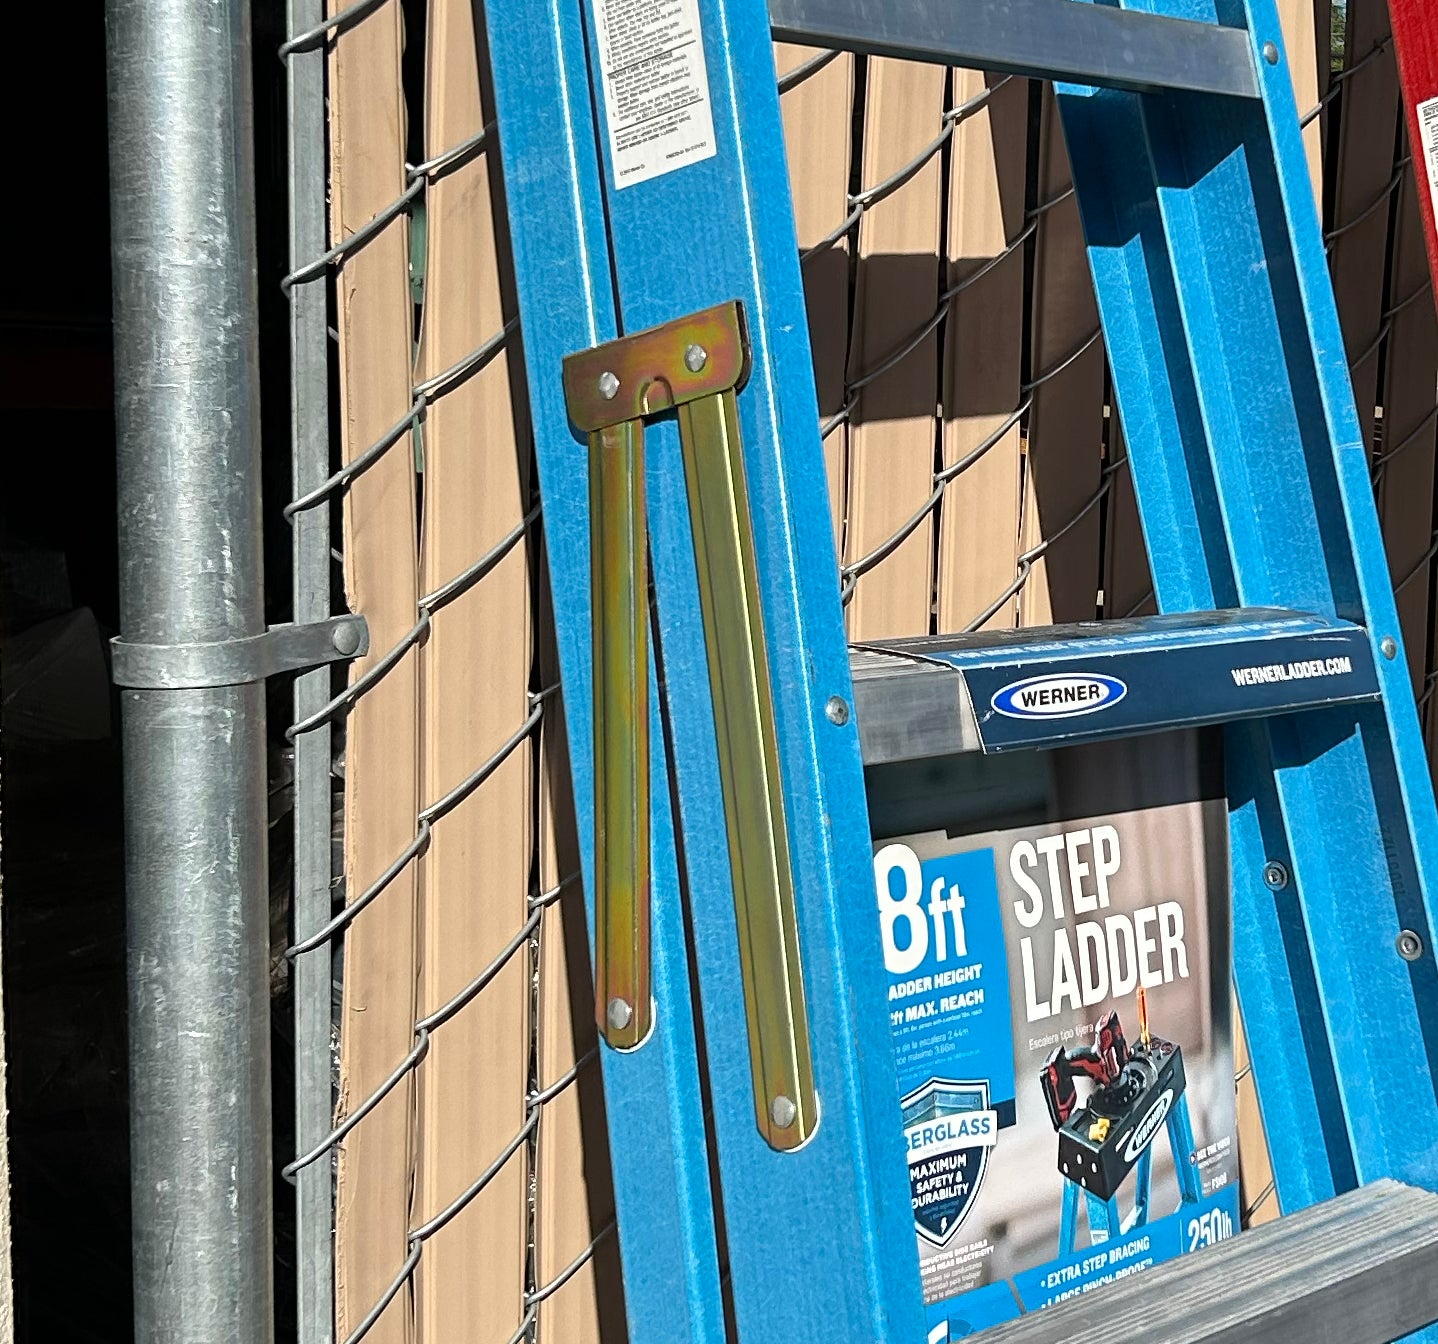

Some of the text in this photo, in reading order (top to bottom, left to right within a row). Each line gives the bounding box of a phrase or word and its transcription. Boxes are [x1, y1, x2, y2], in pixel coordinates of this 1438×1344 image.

[1231, 656, 1352, 687] WERNERLADDER.COM
[1021, 684, 1101, 707] WERNER
[1009, 825, 1121, 928] STEP
[873, 843, 968, 974] 8ft
[1019, 900, 1190, 1023] LADDER
[888, 963, 983, 1001] ADDER HEIGHT
[905, 1001, 938, 1023] MAX.
[940, 988, 985, 1013] REACH
[1061, 1029, 1074, 1043] tipo
[909, 1153, 967, 1182] MAXIMUM
[916, 1171, 954, 1194] SAFETY
[911, 1182, 969, 1210] DURABILITY
[1047, 1235, 1150, 1289] EXTRA STEP BRACING
